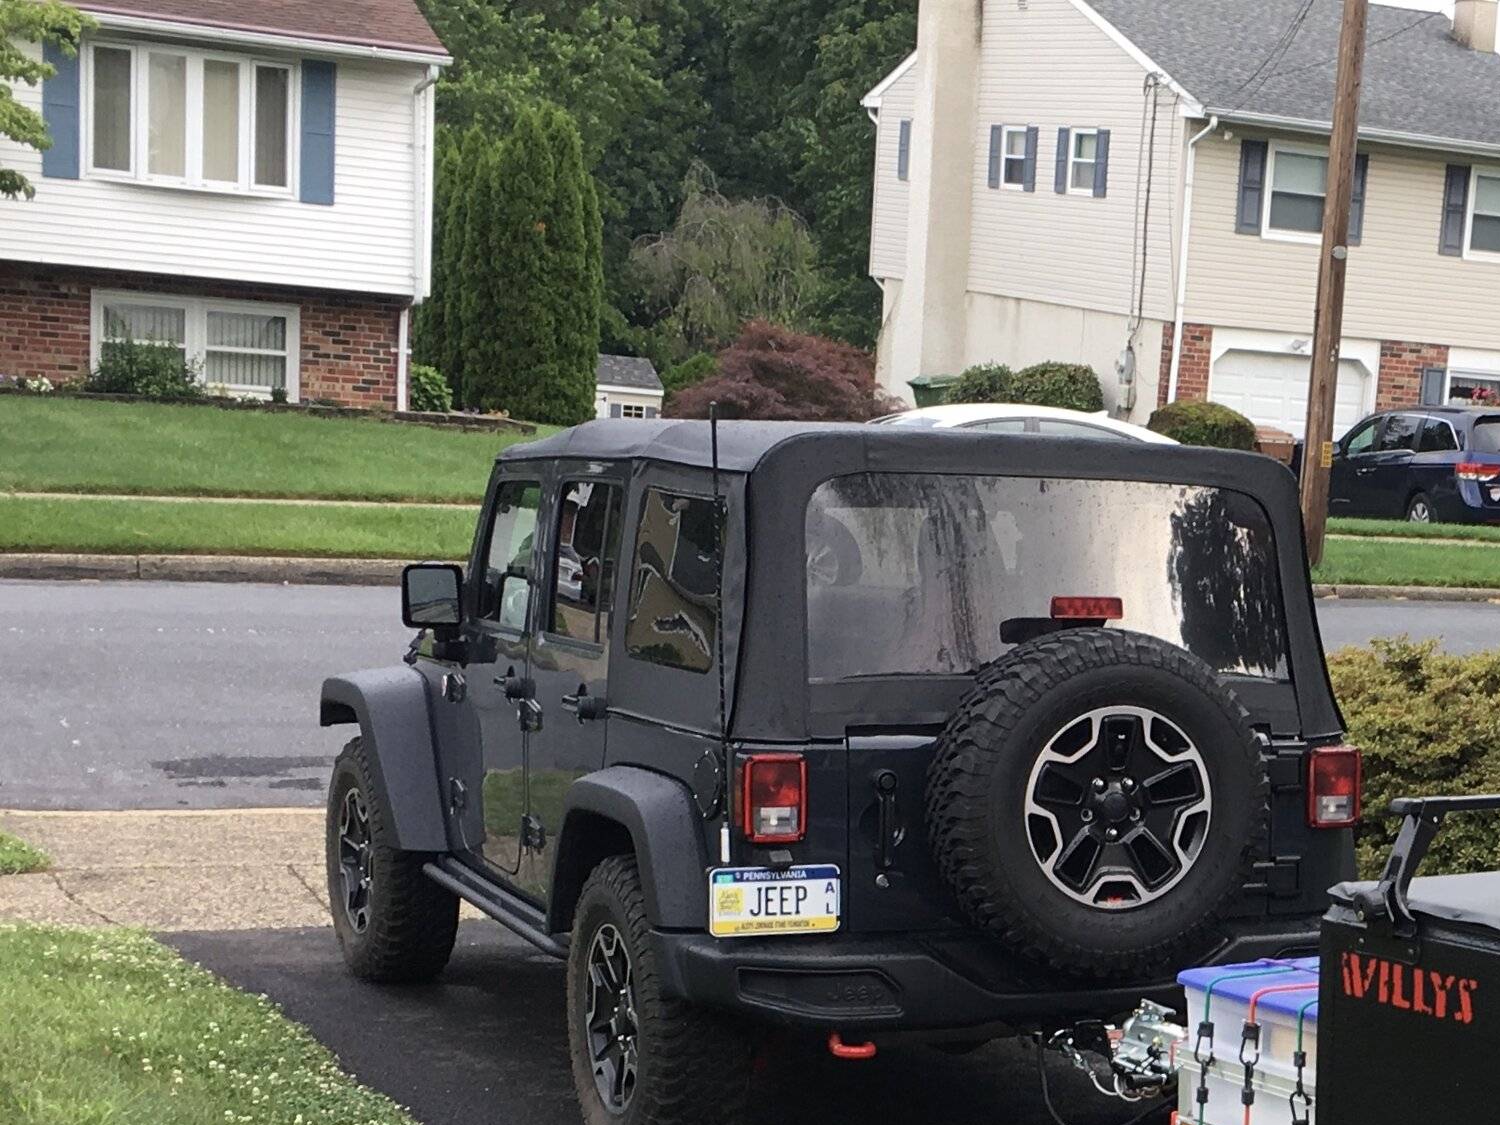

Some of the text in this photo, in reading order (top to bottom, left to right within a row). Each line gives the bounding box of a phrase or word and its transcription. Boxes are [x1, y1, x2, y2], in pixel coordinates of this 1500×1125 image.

[743, 871, 807, 880] PENNSYLVANIA
[825, 882, 835, 893] A
[750, 886, 808, 916] JEEP
[826, 903, 834, 914] L
